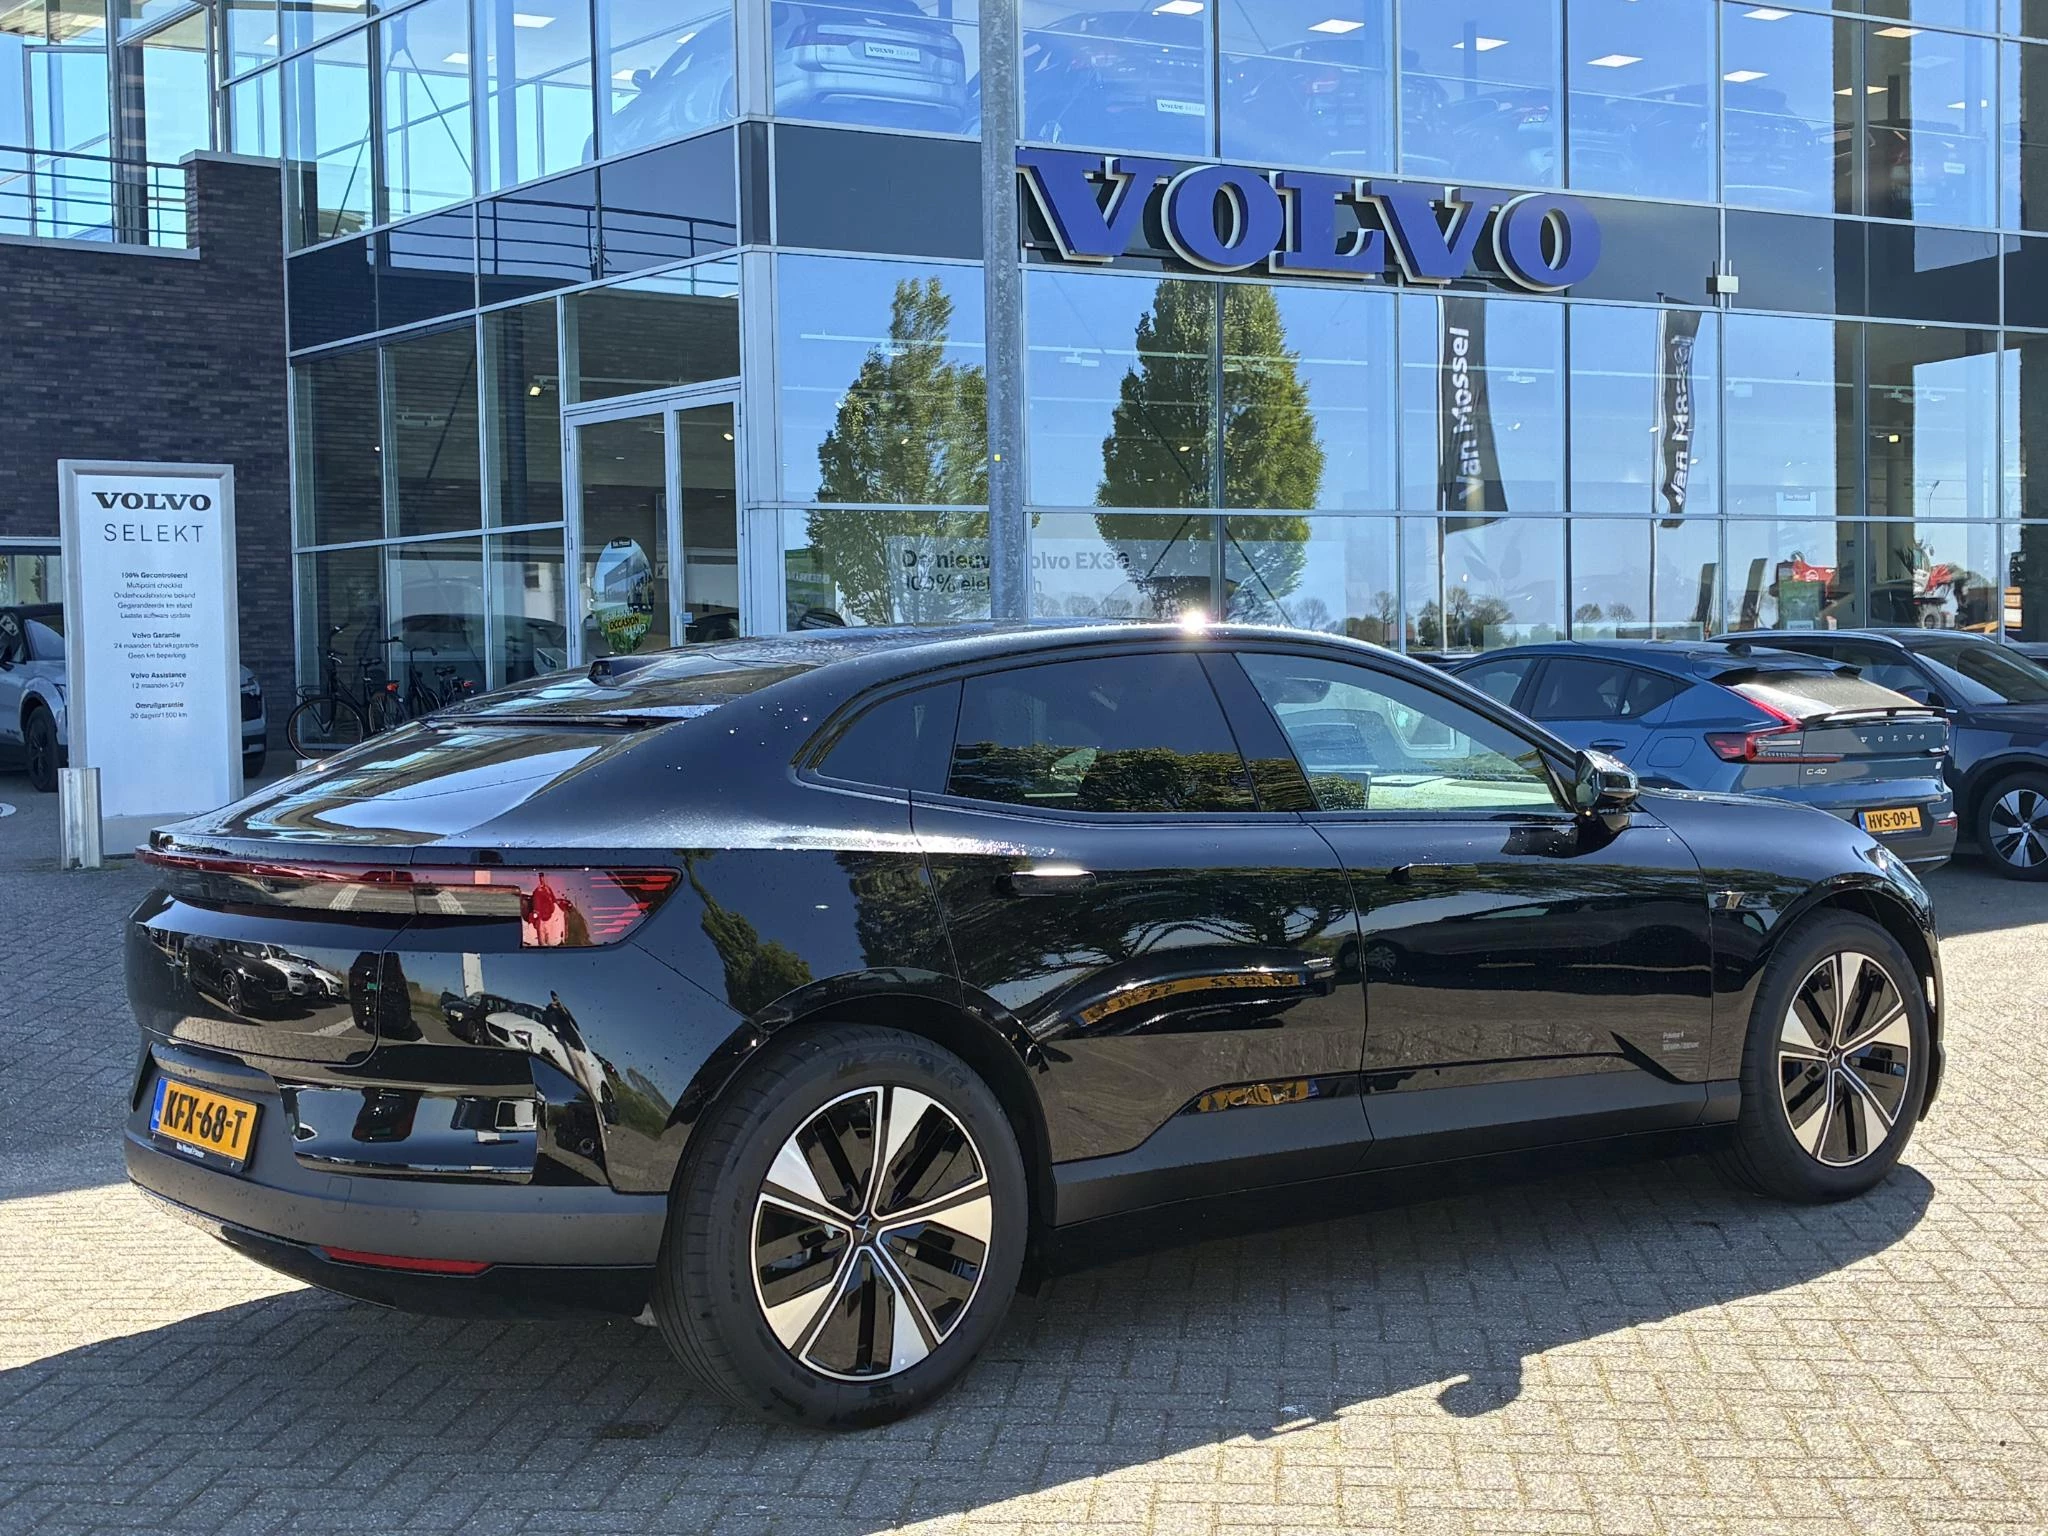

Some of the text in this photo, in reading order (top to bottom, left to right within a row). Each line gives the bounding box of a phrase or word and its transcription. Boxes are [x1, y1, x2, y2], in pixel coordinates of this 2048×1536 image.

[1016, 148, 1601, 293] VOLVO
[1449, 326, 1485, 501] Van Mossel
[91, 492, 212, 512] VOLVO
[104, 523, 204, 543] SELEKT
[1032, 552, 1070, 569] olvo
[1860, 734, 1925, 743] VOLVO
[1868, 811, 1918, 829] HVS-09-L
[163, 1089, 248, 1149] KFX-68-T
